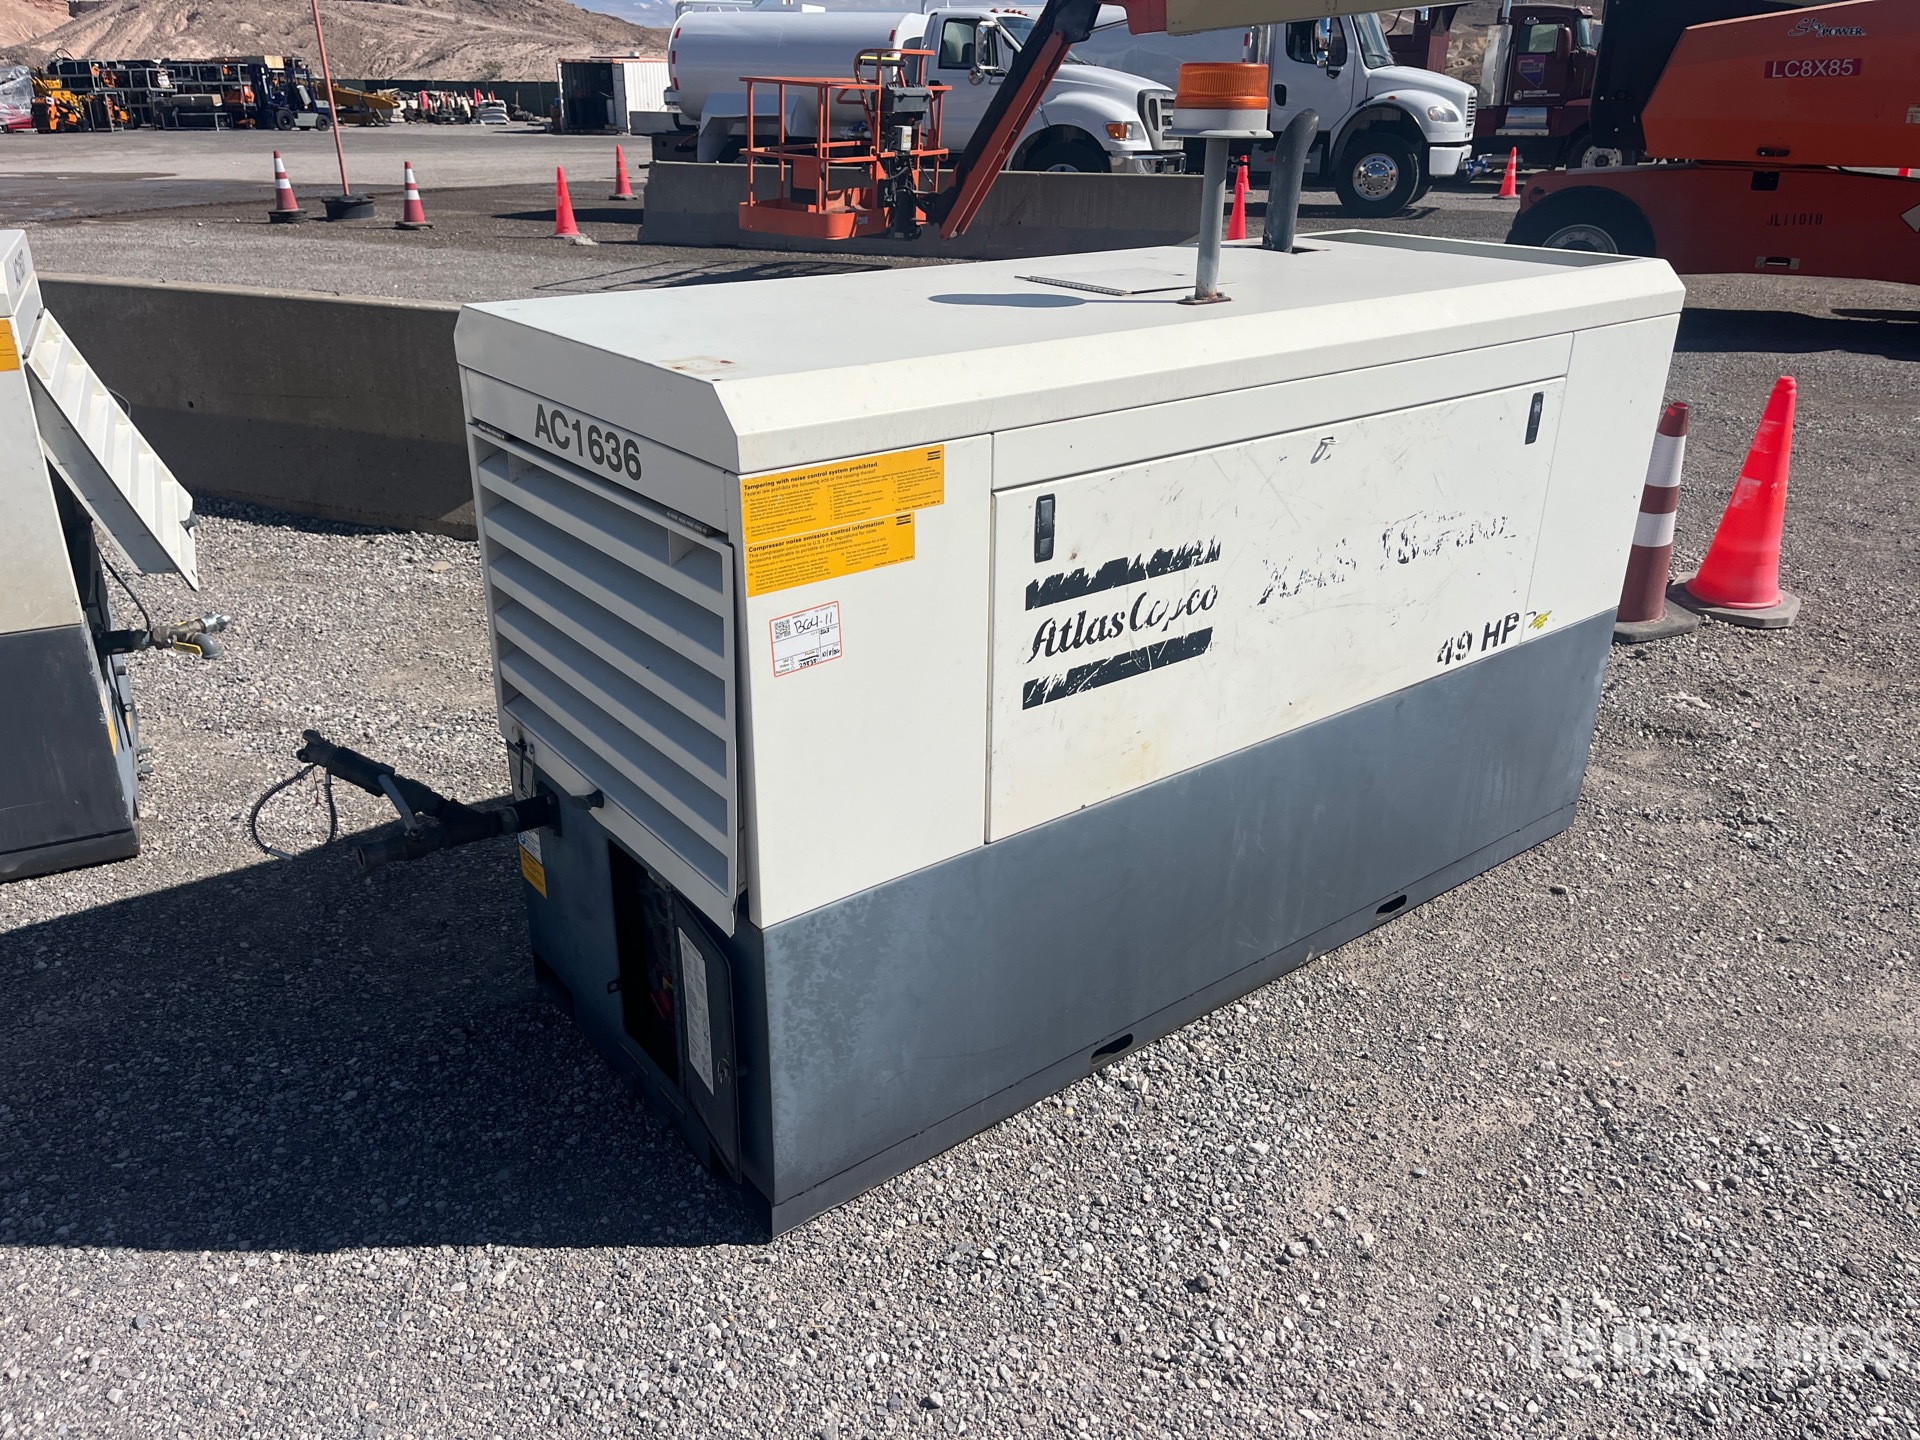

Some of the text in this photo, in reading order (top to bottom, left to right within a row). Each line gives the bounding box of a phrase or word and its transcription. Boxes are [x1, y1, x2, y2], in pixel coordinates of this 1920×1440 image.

[1771, 59, 1854, 77] LC8X85
[535, 404, 641, 481] AC1636
[744, 481, 774, 492] Tampering
[829, 468, 848, 476] system
[748, 541, 784, 554] Compressor
[804, 532, 829, 541] emission
[830, 527, 850, 536] control
[852, 520, 884, 531] information
[1026, 611, 1125, 663] Atlas
[1436, 612, 1520, 665] 49 HP
